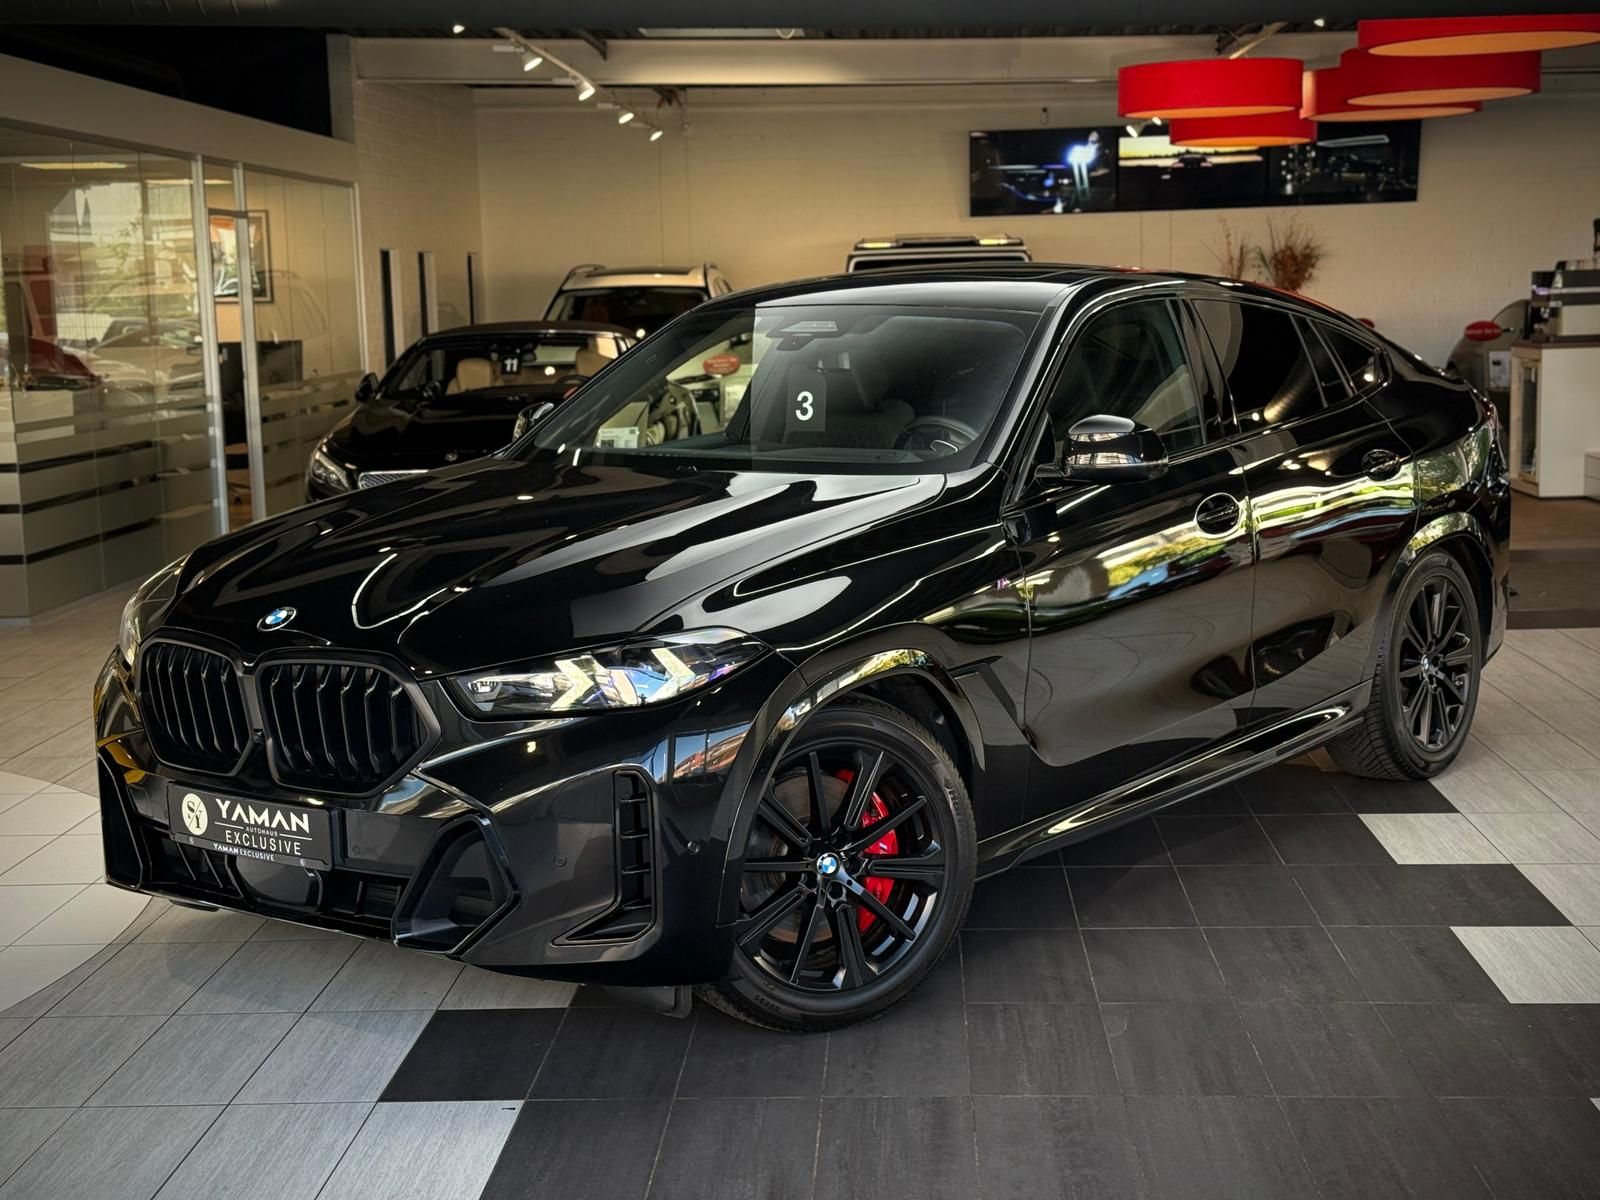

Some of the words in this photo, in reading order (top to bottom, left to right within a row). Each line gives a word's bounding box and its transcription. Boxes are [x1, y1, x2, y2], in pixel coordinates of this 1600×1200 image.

[504, 358, 518, 372] 11
[795, 391, 814, 421] 3
[215, 798, 309, 834] YAMAN
[245, 826, 278, 836] AUTOHAUS
[213, 842, 239, 855] YAMAN
[239, 848, 275, 862] EXCLUSIVE
[225, 830, 301, 856] EXCLUSIVE
